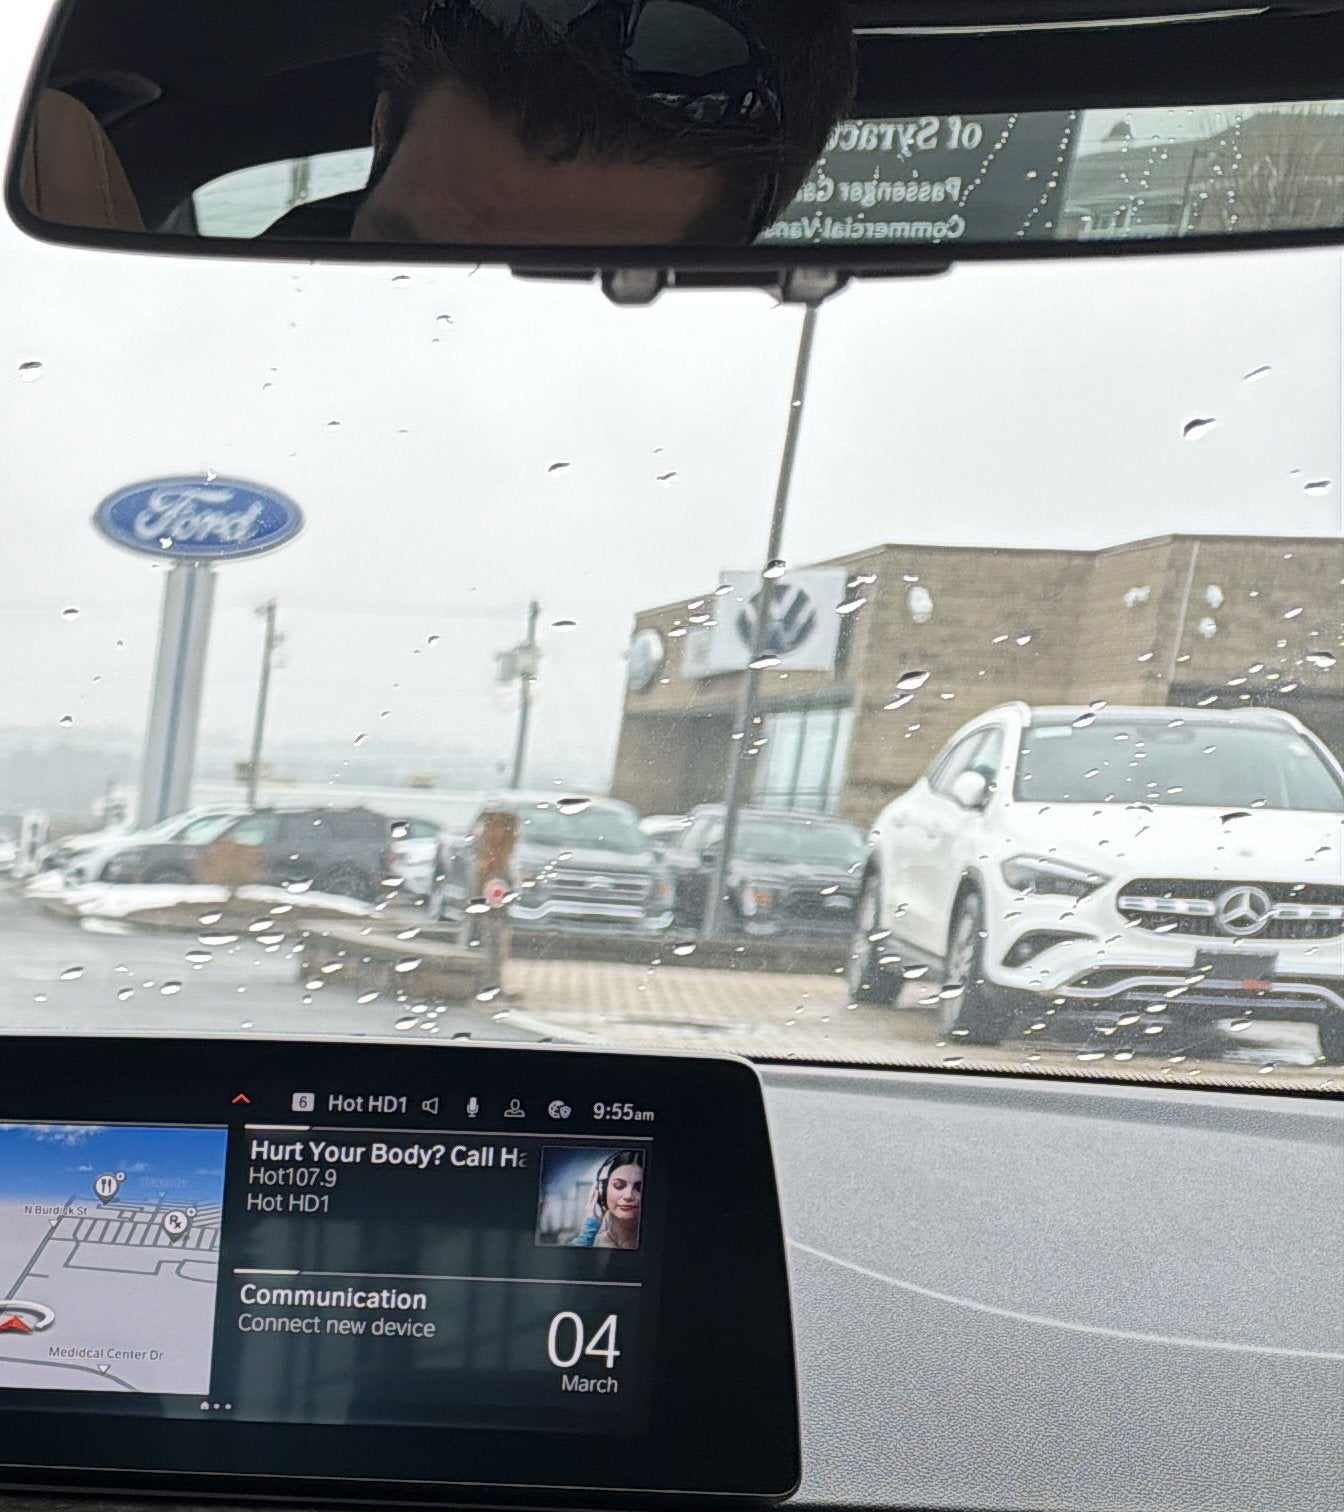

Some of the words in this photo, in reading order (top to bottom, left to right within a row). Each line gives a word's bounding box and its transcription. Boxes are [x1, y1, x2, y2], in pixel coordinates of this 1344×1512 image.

[133, 487, 264, 542] Ford
[328, 1094, 363, 1112] Hot
[368, 1096, 407, 1113] HD1
[251, 1141, 303, 1161] Hurt
[310, 1142, 366, 1164] Your
[371, 1144, 445, 1169] Body?
[450, 1146, 494, 1168] Call
[248, 1166, 337, 1188] Hot107.9
[24, 1205, 33, 1215] N
[35, 1205, 74, 1216] Burdick
[76, 1206, 88, 1216] St
[247, 1193, 283, 1212] Hot
[288, 1195, 330, 1213] HD1
[240, 1283, 428, 1311] Communication
[238, 1313, 321, 1334] Connect
[326, 1319, 366, 1336] new
[371, 1317, 436, 1338] device
[547, 1310, 621, 1370] 04
[106, 1347, 147, 1361] Center
[150, 1349, 165, 1362] Dr
[561, 1373, 619, 1395] March
